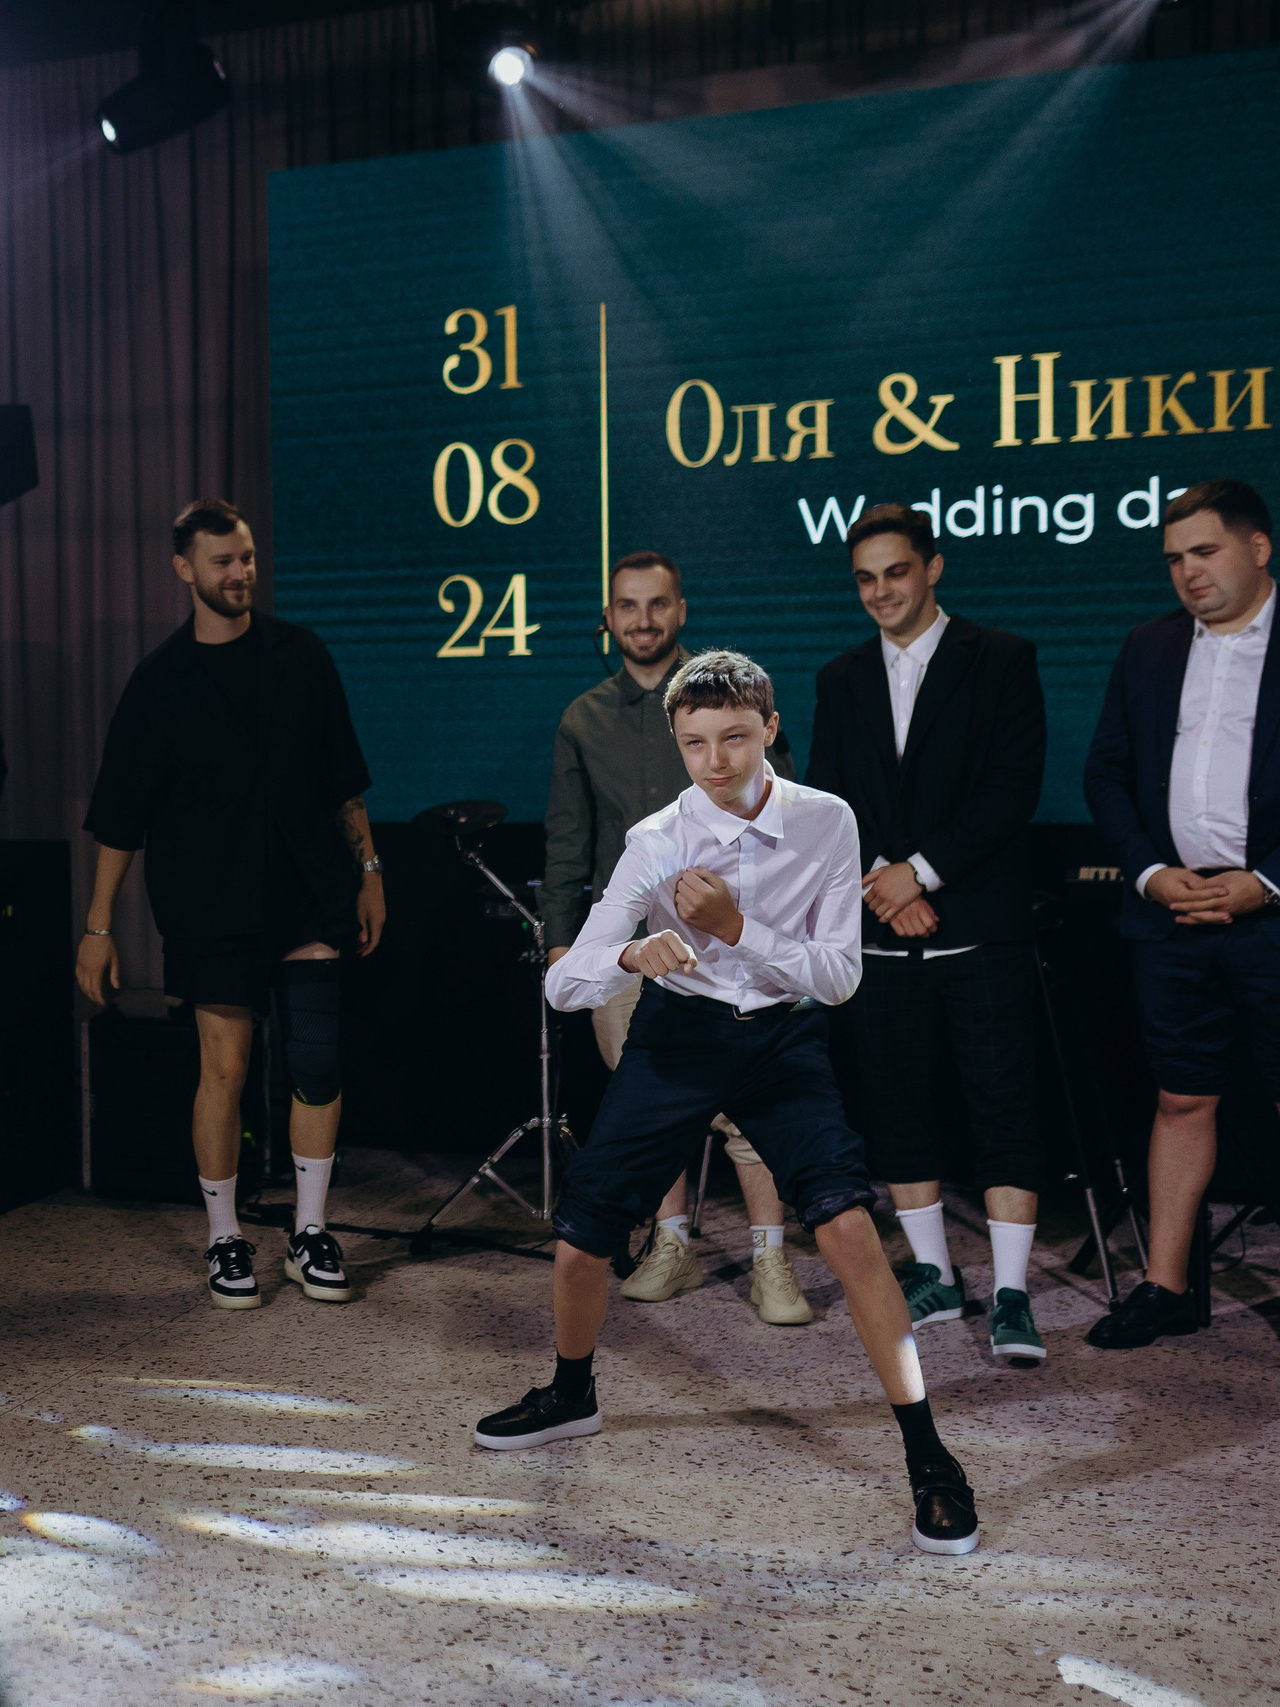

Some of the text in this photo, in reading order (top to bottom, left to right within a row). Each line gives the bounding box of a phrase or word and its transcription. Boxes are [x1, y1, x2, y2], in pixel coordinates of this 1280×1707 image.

[442, 304, 524, 395] 31
[665, 350, 1274, 468] Оля & Ники
[432, 438, 541, 528] 08
[797, 484, 1095, 546] Wdding
[436, 573, 542, 659] 24
